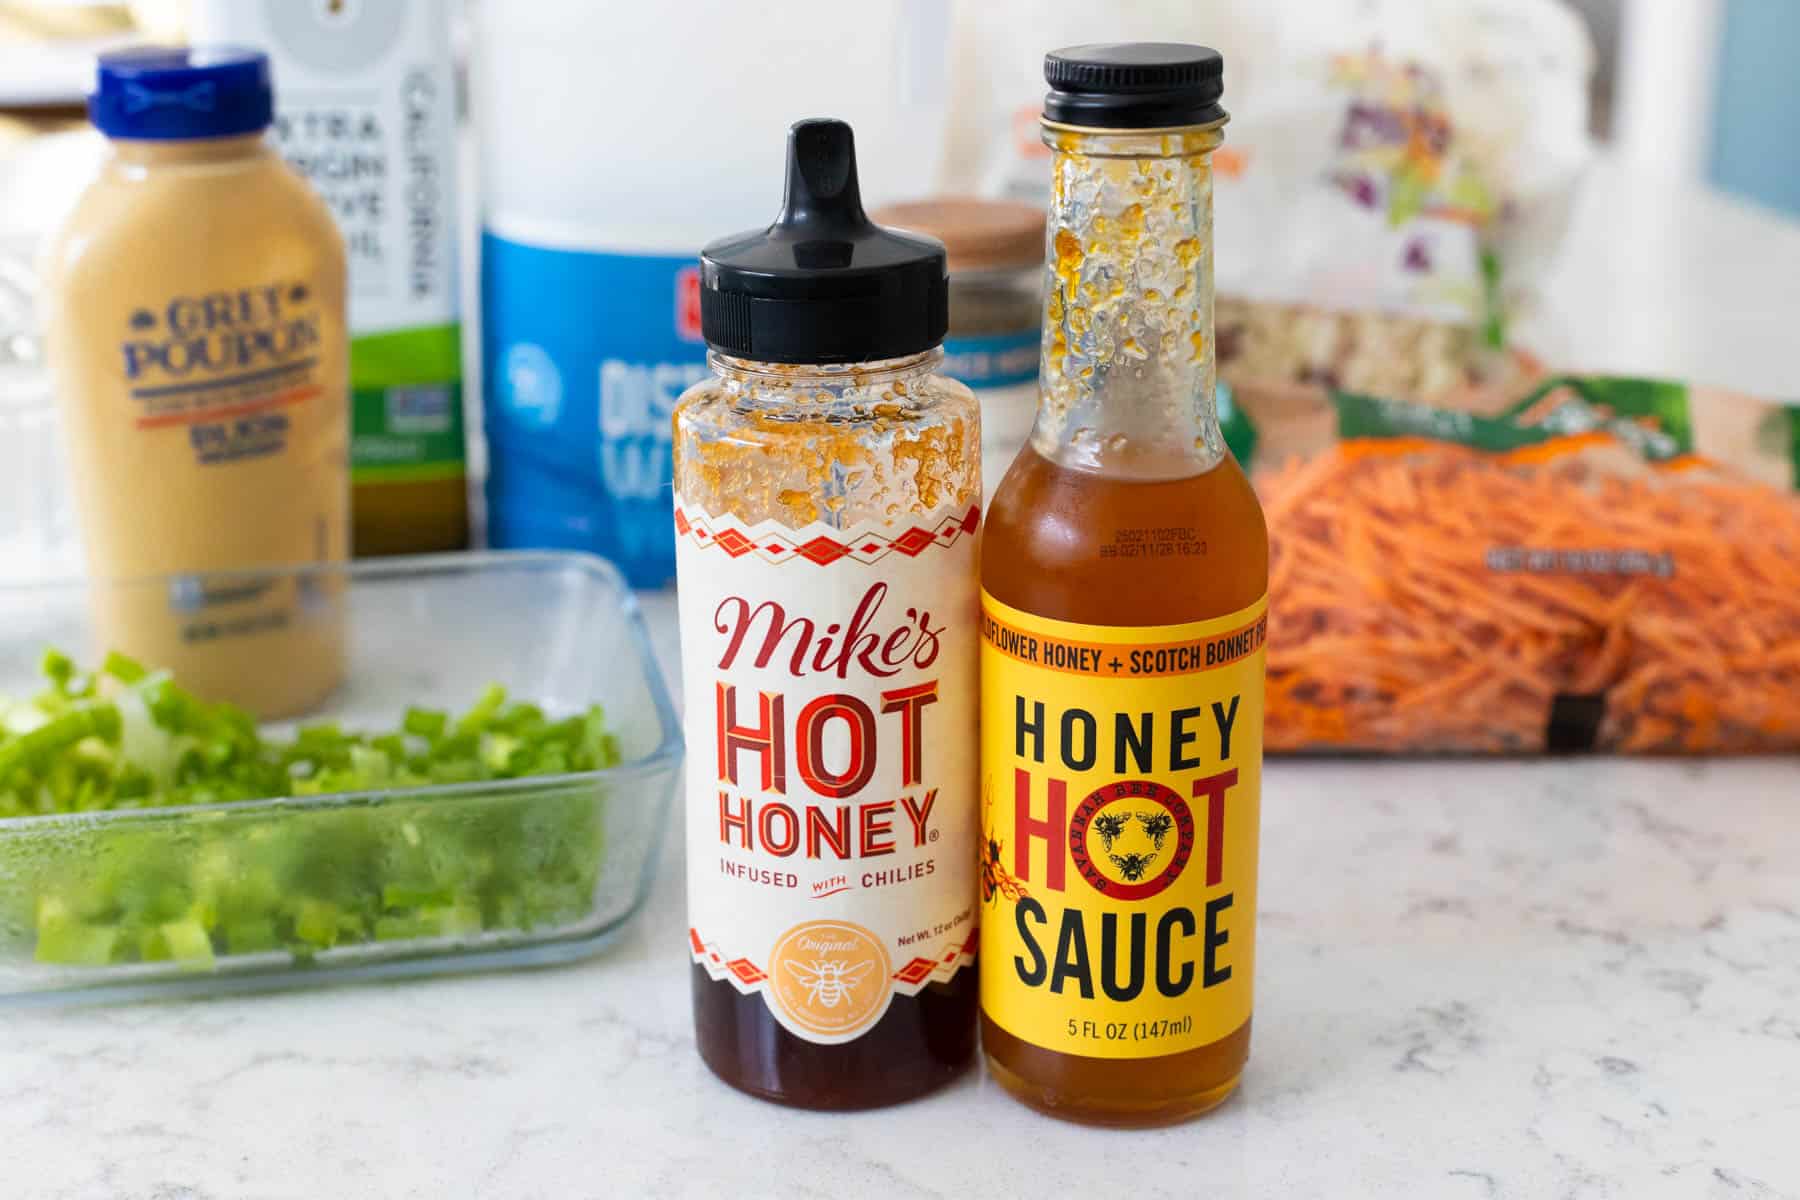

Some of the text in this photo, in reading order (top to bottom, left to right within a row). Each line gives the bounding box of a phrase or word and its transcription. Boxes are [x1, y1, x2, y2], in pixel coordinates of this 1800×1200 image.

[121, 316, 319, 381] POUPON
[714, 581, 947, 680] Mike's
[1043, 640, 1102, 672] HONEY
[1130, 644, 1200, 674] SCOTCH
[1206, 625, 1255, 667] BONNET
[716, 679, 939, 799] HOT
[1014, 694, 1241, 775] HONEY
[717, 787, 939, 860] HONEY
[1014, 767, 1239, 901] HOT
[720, 857, 936, 893] INFUSED WITH CHILIES
[897, 934, 915, 947] Net
[1014, 892, 1234, 1002] SAUCE
[1067, 1015, 1193, 1041] 5 FL OZ (147ml)
